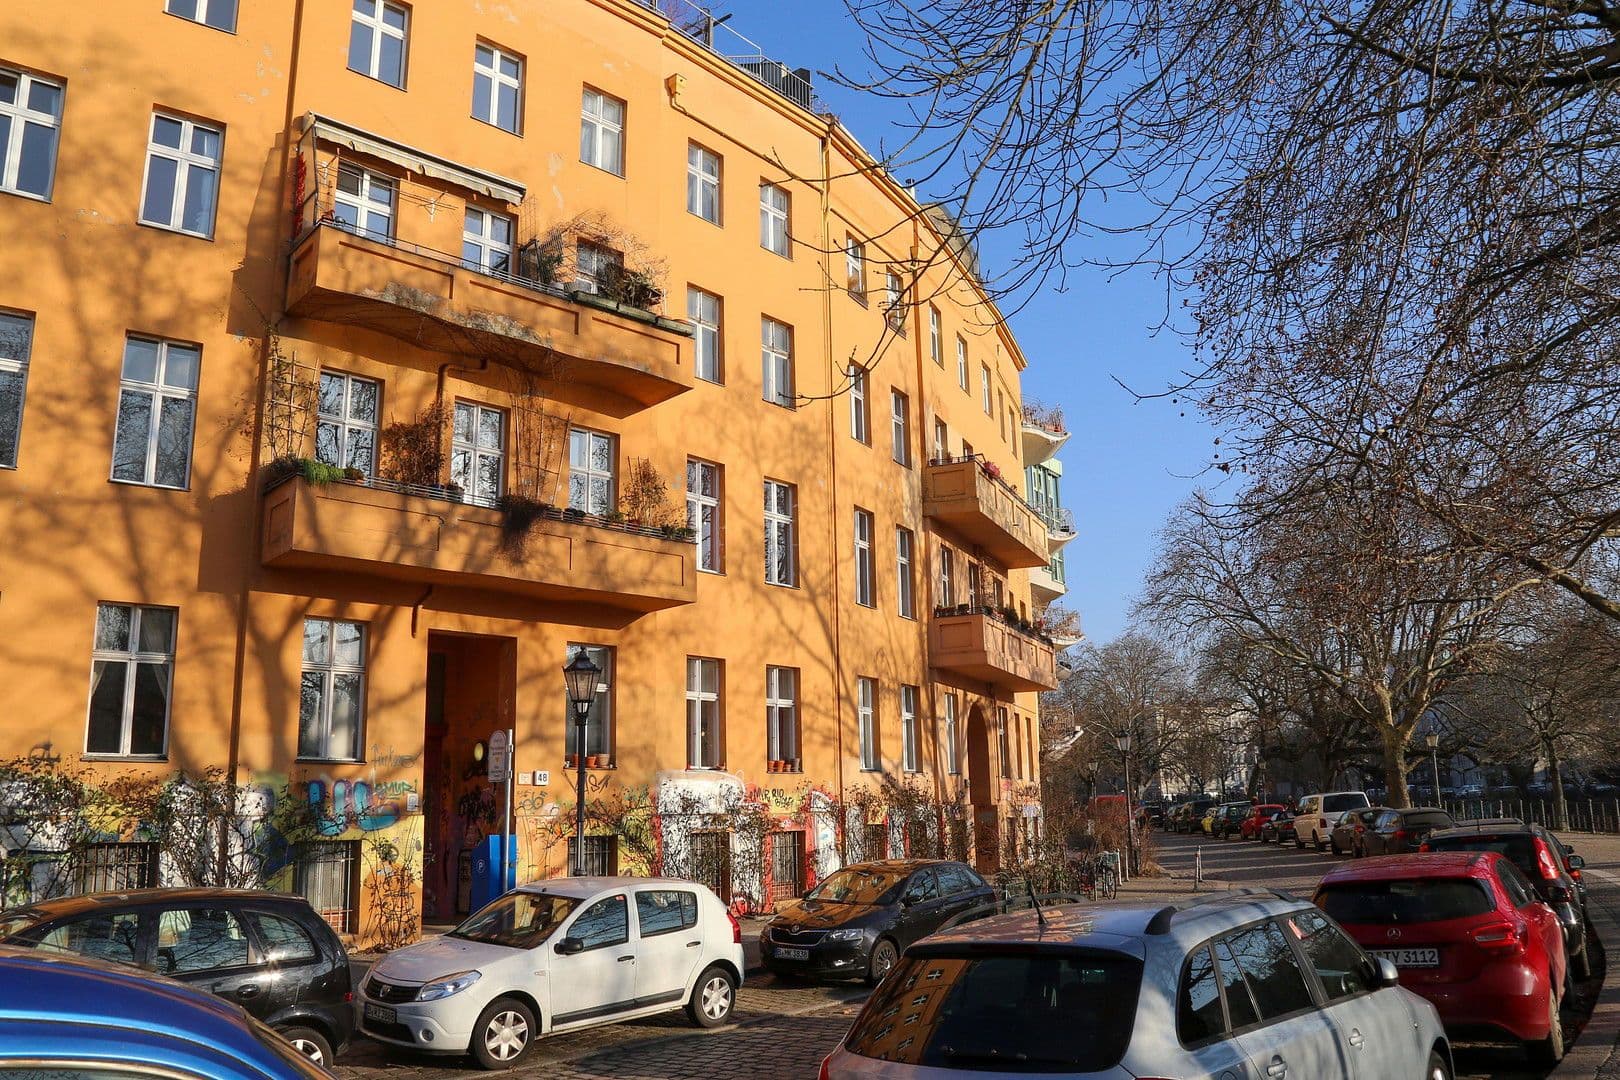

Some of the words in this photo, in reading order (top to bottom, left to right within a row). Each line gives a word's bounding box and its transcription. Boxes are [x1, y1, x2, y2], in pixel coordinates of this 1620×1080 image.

[538, 773, 548, 782] 48
[1383, 951, 1400, 963] TY
[1403, 950, 1437, 964] 3112
